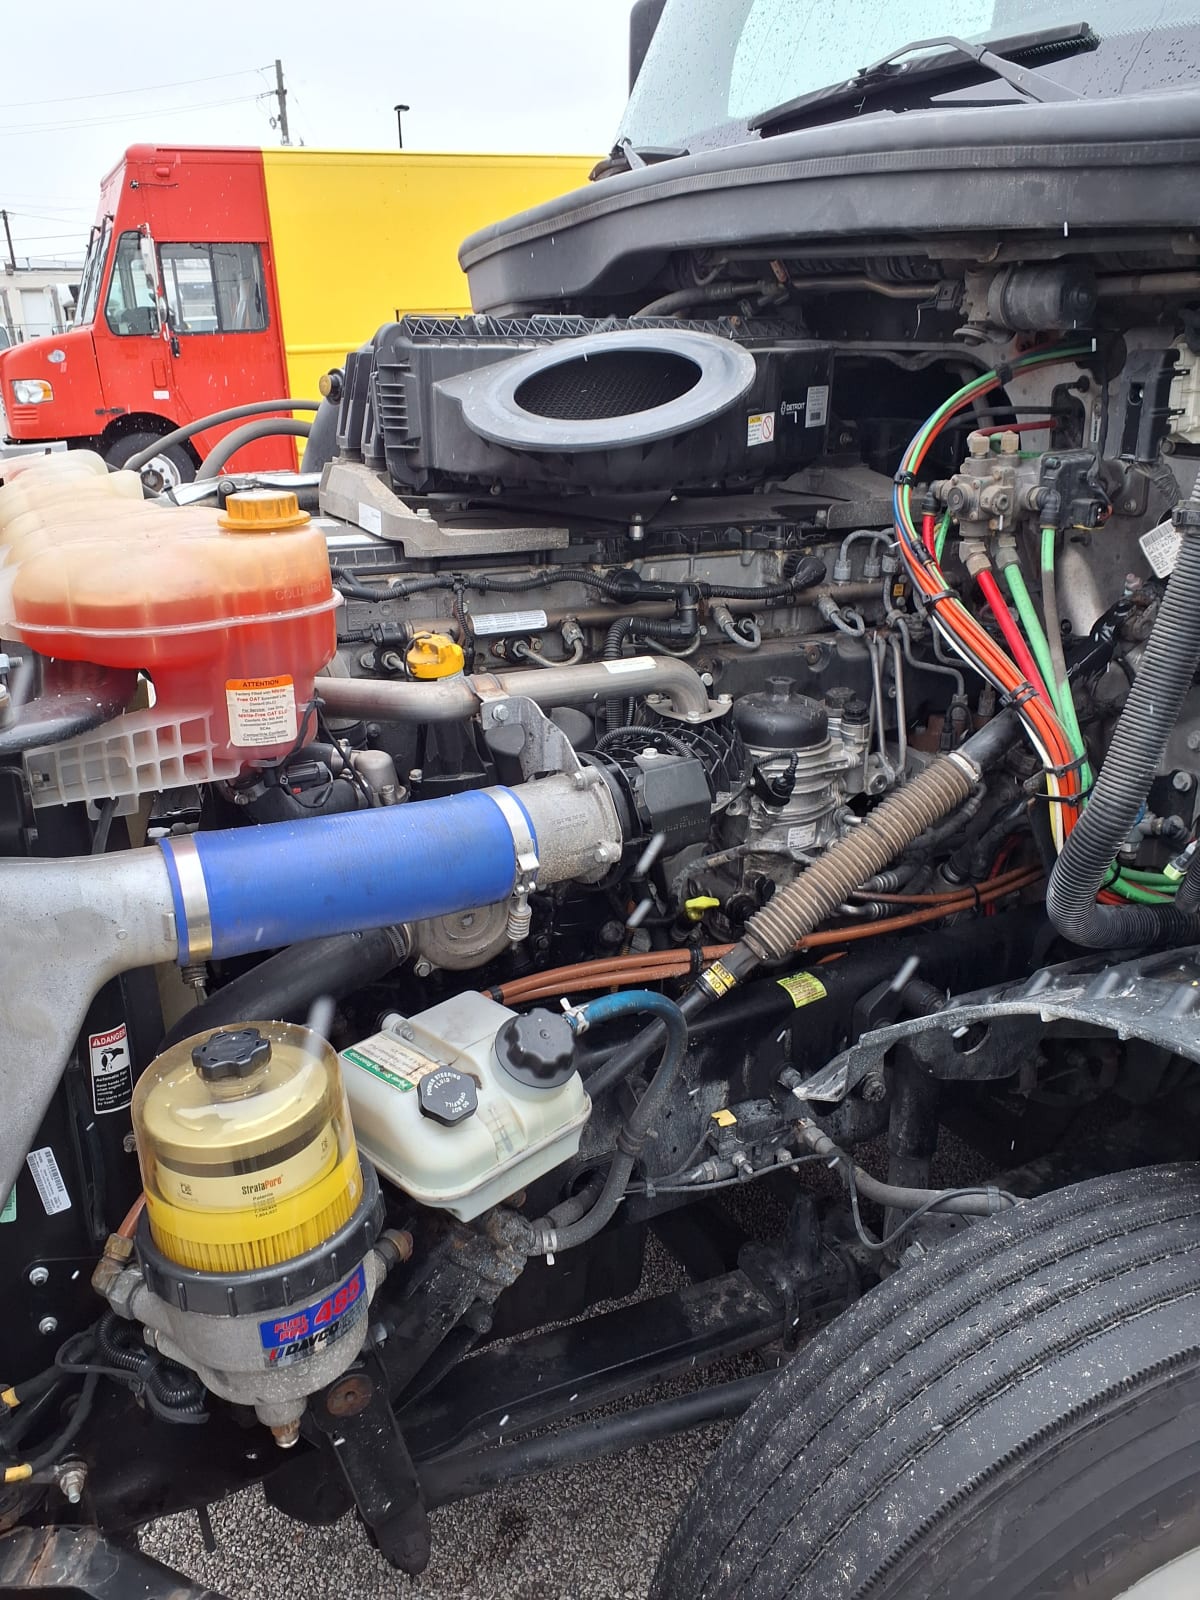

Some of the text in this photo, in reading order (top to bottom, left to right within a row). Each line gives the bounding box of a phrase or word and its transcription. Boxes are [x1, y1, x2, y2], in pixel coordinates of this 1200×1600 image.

[713, 963, 731, 981] STEP
[711, 976, 721, 989] NO
[434, 1071, 461, 1081] STEERING
[241, 1176, 282, 1195] StrataPore
[314, 1274, 360, 1325] 485
[274, 1315, 309, 1334] FUEL
[279, 1321, 309, 1342] PRO
[285, 1321, 339, 1356] DAVCO
